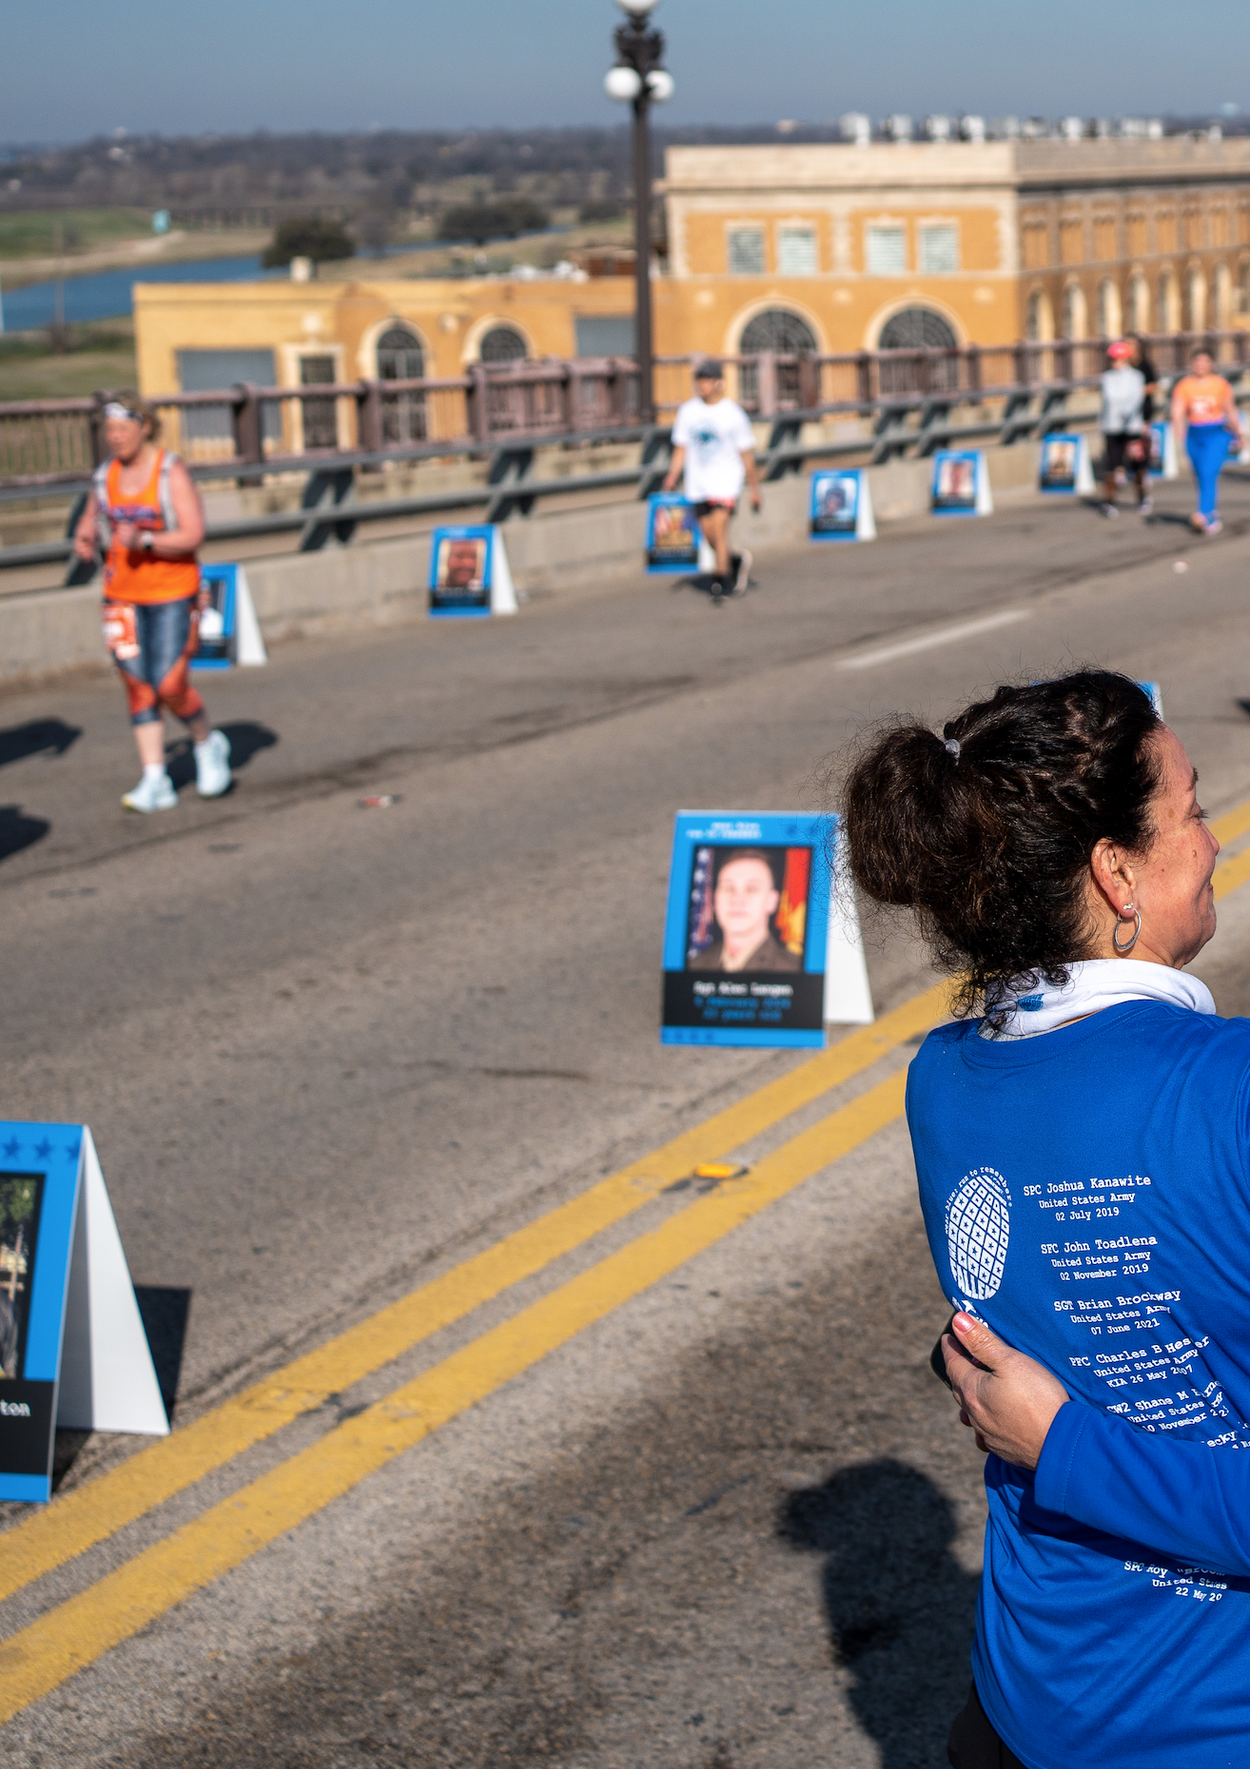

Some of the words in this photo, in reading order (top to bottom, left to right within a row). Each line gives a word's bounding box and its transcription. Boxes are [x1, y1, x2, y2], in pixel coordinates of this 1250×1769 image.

[969, 1169, 978, 1177] to
[1023, 1184, 1042, 1196] SPC
[1047, 1181, 1085, 1194] Joshua
[1090, 1175, 1152, 1189] Kanawite
[1039, 1197, 1069, 1209] United
[1072, 1195, 1106, 1206] States
[1109, 1192, 1136, 1203] Army
[1055, 1212, 1066, 1222] 02
[1069, 1210, 1091, 1221] July
[1095, 1206, 1120, 1218] 2019
[1063, 1241, 1091, 1253] John
[1094, 1235, 1158, 1250] Toadlena
[1051, 1257, 1082, 1268] United
[1085, 1255, 1119, 1266] States
[1124, 1251, 1151, 1261] Army
[1060, 1272, 1071, 1281] 02
[1073, 1269, 1117, 1280] November
[1122, 1263, 1149, 1275] 2019
[1053, 1300, 1074, 1312] SGT
[1077, 1299, 1113, 1311] Brian
[1116, 1290, 1181, 1307] Brockway
[1070, 1313, 1103, 1324] United
[1105, 1310, 1141, 1321] States
[1090, 1326, 1102, 1336] 07
[1107, 1324, 1131, 1334] June
[1134, 1318, 1160, 1329] 2021
[1095, 1349, 1148, 1364] Charles
[1151, 1344, 1163, 1354] B
[1164, 1335, 1210, 1354] Heser
[1093, 1364, 1132, 1378] United
[1134, 1357, 1171, 1371] States
[1173, 1348, 1199, 1365] Army
[1106, 1377, 1128, 1388] KIA
[1130, 1373, 1144, 1384] 26
[1146, 1370, 1168, 1381] May
[1106, 1402, 1131, 1415] CW2
[1134, 1397, 1174, 1411] Shane
[1176, 1390, 1190, 1401] M
[1127, 1409, 1167, 1424] United
[1168, 1400, 1205, 1417] States
[1158, 1411, 1208, 1431] November
[1206, 1430, 1238, 1448] ecky
[1146, 1564, 1168, 1579] Roy
[1152, 1576, 1194, 1587] United
[1175, 1586, 1189, 1597] 22
